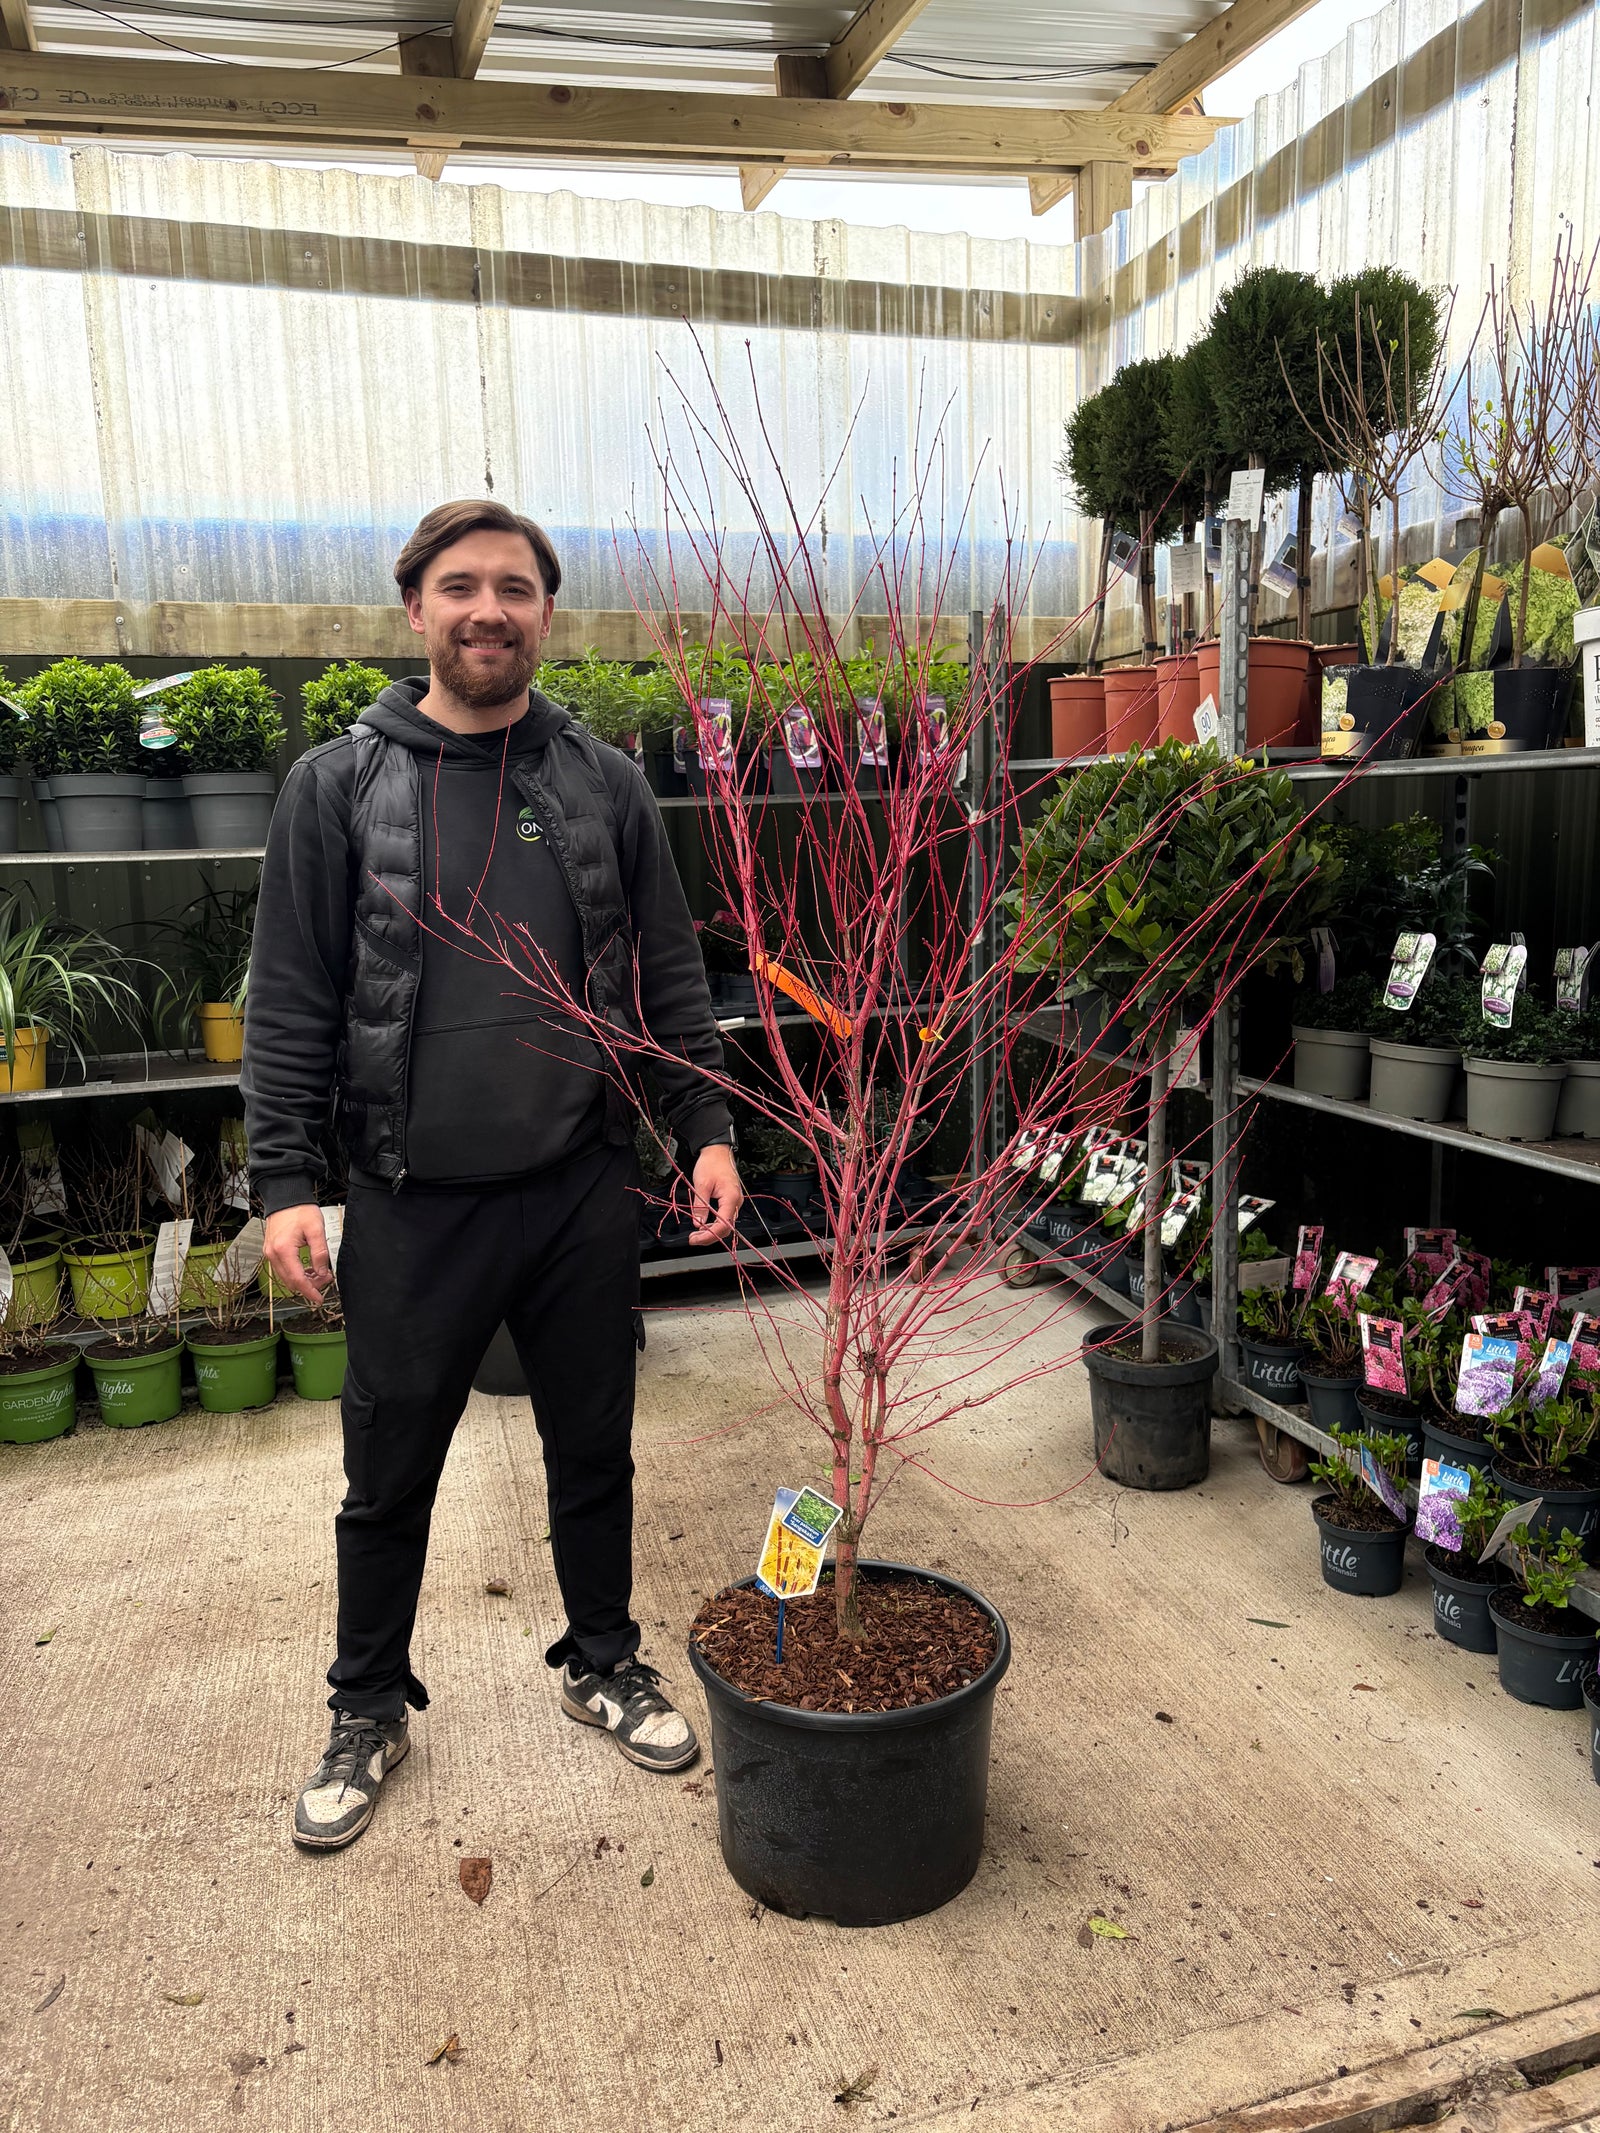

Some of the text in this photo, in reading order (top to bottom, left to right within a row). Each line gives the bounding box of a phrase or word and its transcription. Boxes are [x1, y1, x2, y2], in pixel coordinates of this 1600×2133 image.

[272, 102, 319, 116] ECC
[1486, 1343, 1511, 1356] Little
[1252, 1360, 1298, 1382] Little
[1442, 1471, 1465, 1486] Little
[1321, 1539, 1358, 1570] ittle
